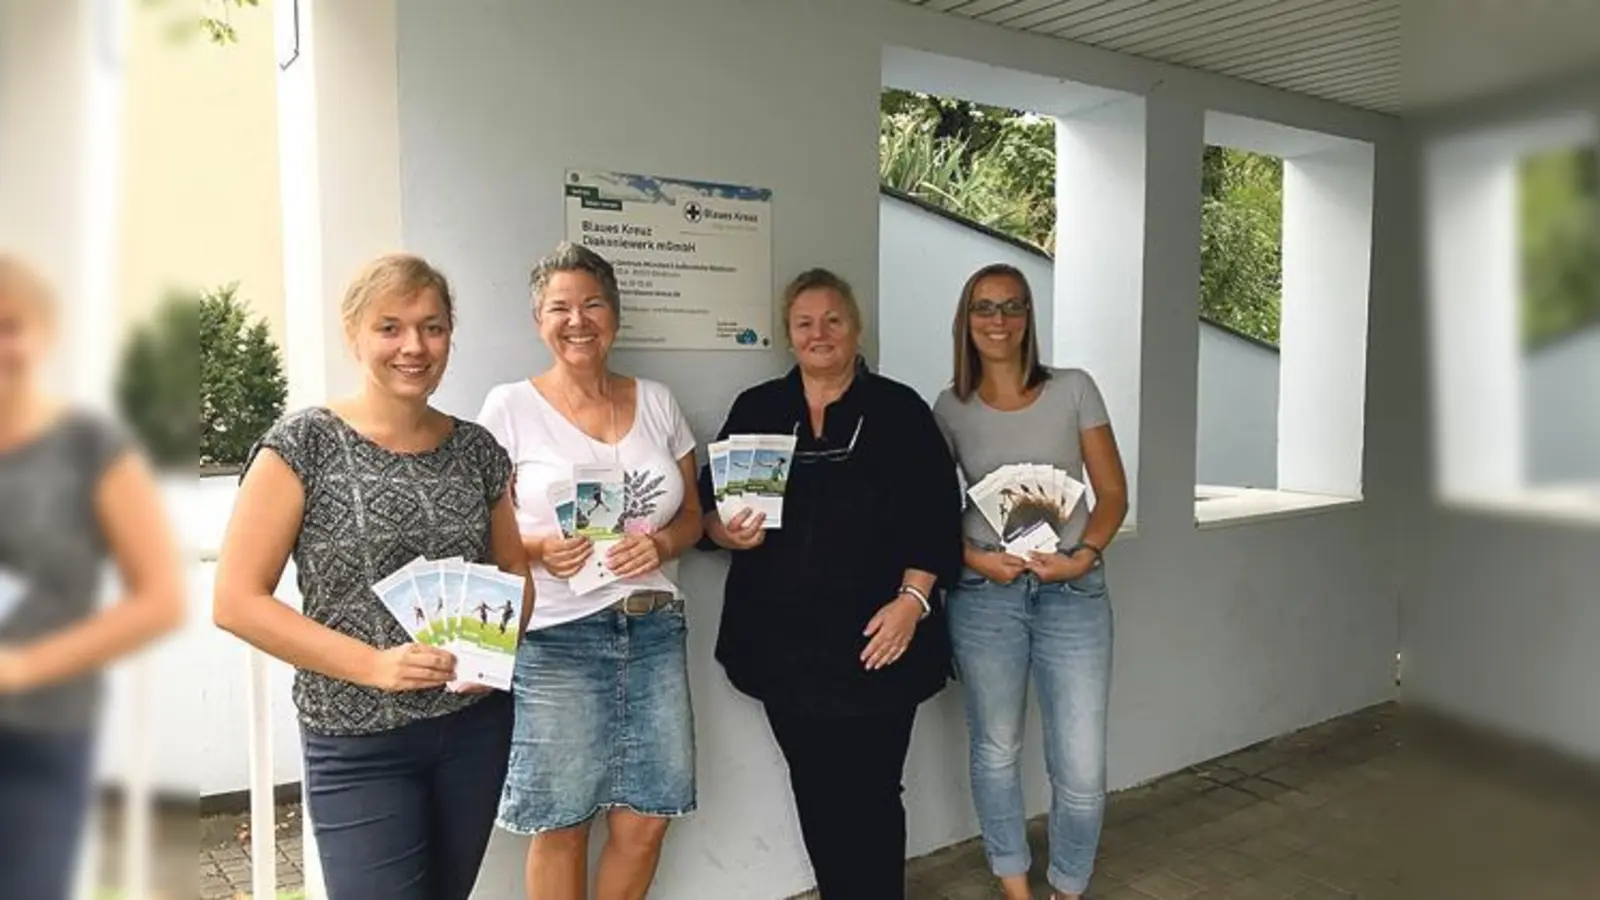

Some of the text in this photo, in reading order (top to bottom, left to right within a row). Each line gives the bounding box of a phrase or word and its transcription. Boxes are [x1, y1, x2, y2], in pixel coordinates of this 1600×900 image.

[704, 208, 758, 222] Blaues Kreuz
[582, 220, 652, 236] Blaues Kreuz
[583, 235, 654, 250] Diakoniewerk
